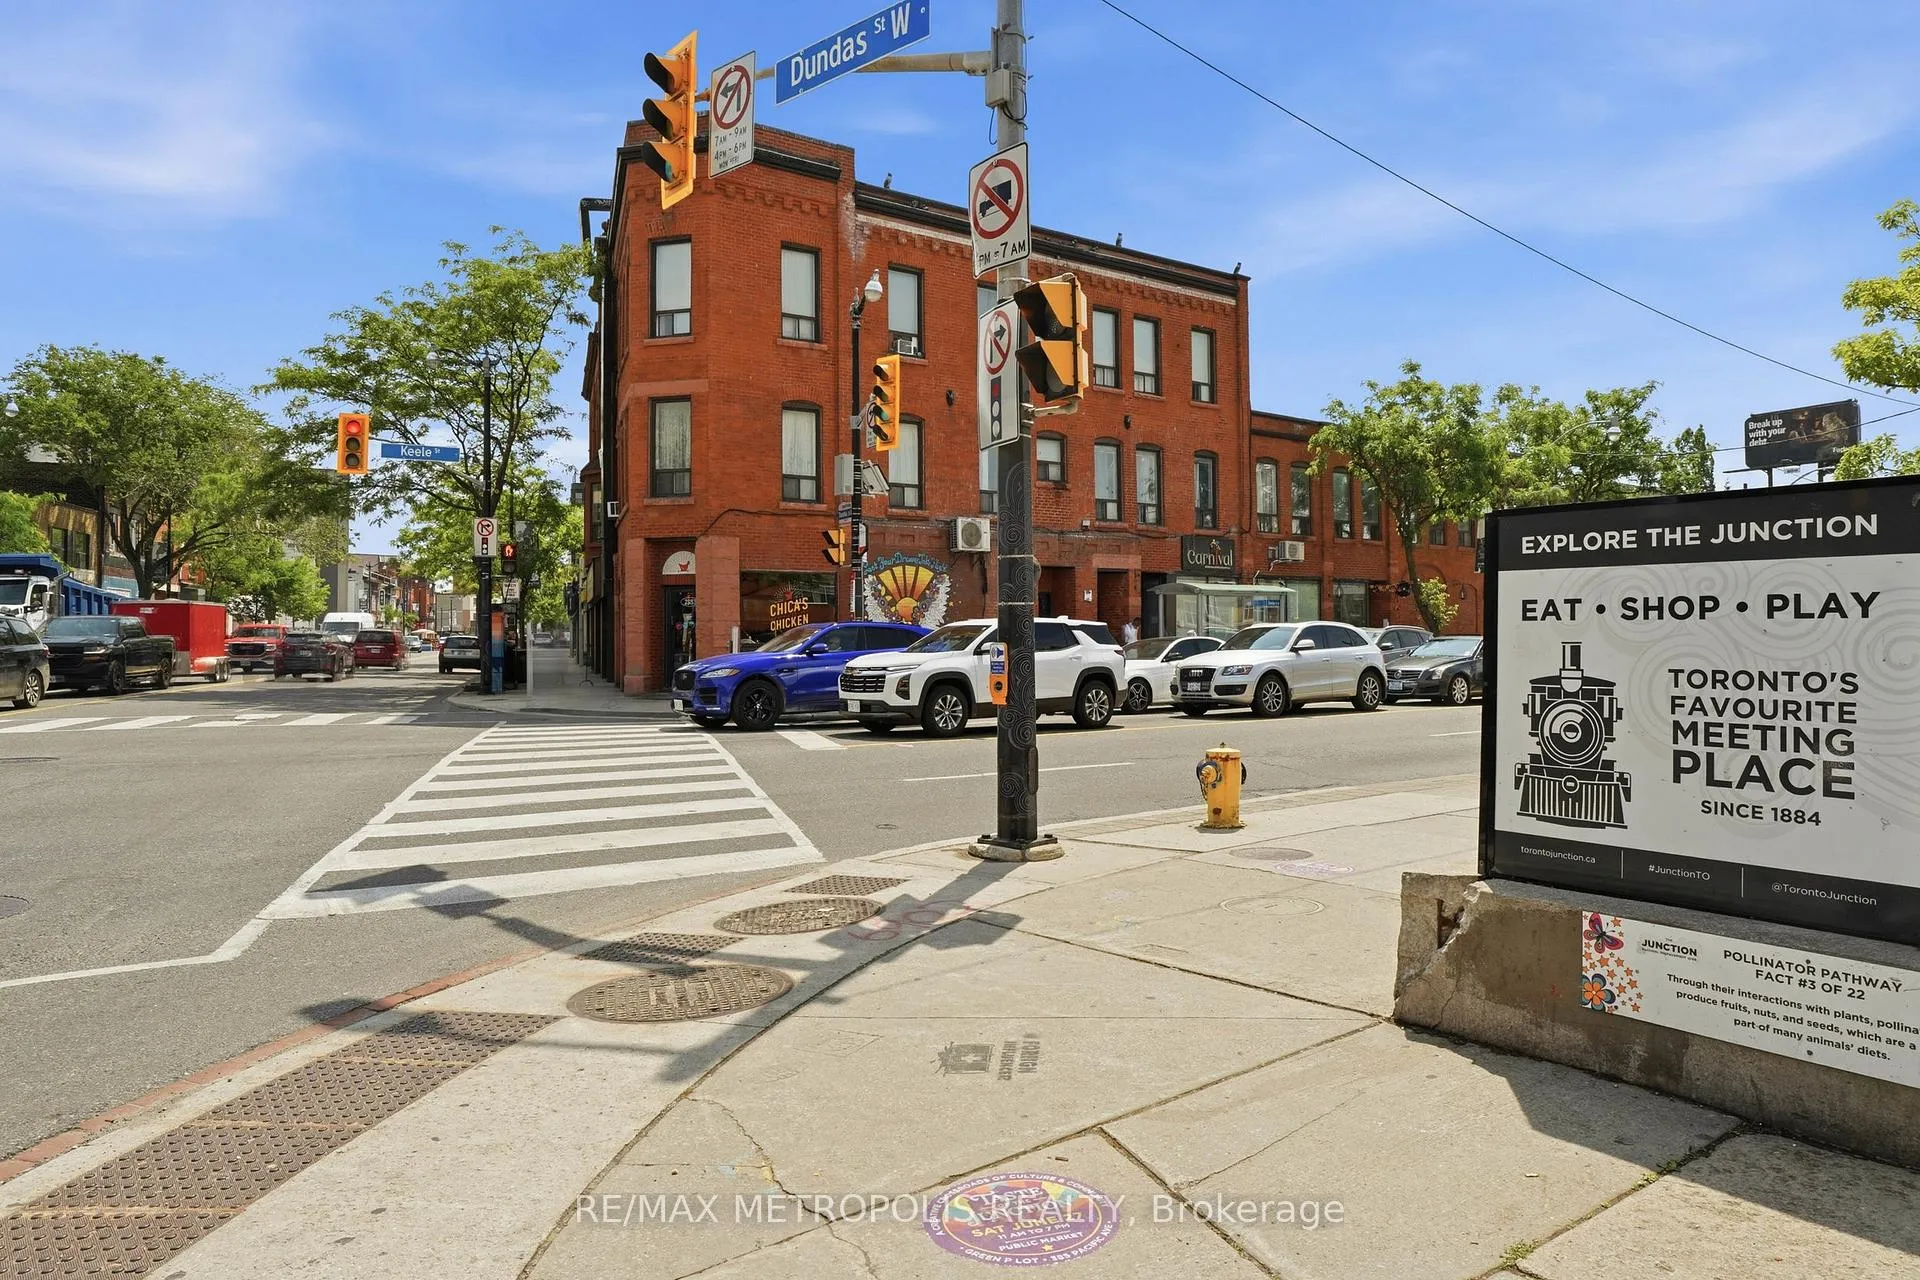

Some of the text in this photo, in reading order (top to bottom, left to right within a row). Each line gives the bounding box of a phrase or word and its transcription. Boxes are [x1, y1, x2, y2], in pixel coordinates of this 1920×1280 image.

[790, 3, 910, 87] Dundas St W
[1748, 419, 1783, 430] Break up
[1748, 427, 1787, 438] with your
[401, 445, 432, 457] Keele
[1521, 513, 1878, 555] EXPLORE THE JUNCTION
[1187, 549, 1233, 566] Carnival
[770, 597, 809, 617] CHICA'S
[1521, 591, 1881, 622] EAT SHOP PLAY
[770, 614, 809, 631] CHICKEN
[1668, 668, 1859, 695] TORONTO'S
[1670, 695, 1857, 724] FAVOURITE
[1672, 720, 1855, 756] MEETING
[1672, 749, 1856, 800] PLACE
[1700, 799, 1821, 826] SINCE 1884
[1521, 845, 1596, 864] torontojunction.ca
[1648, 864, 1710, 881] #JunctionTO
[1771, 882, 1877, 906] @TorontoJunction
[1641, 939, 1697, 956] JUNCTION
[1723, 949, 1816, 976] POLLINATOR
[1821, 968, 1903, 993] PATHWAY
[1755, 969, 1865, 1000] FACT #3 OF 22
[1667, 973, 1920, 1036] Through their interactions with plants, pollina
[1676, 991, 1917, 1051] produce fruits, nuts, and seeds, which are a
[1733, 1018, 1756, 1031] part
[1758, 1023, 1770, 1033] of
[1773, 1028, 1804, 1041] many
[1857, 1046, 1891, 1061] diets.
[1008, 1173, 1057, 1181] CULTURE
[968, 1189, 1043, 1206] TASTE
[971, 1224, 1005, 1238] SAT
[1012, 1215, 1058, 1231] JUNE
[1010, 1230, 1027, 1239] AM
[1027, 1227, 1044, 1235] TO
[1054, 1222, 1070, 1231] PM
[965, 1248, 1004, 1264] GREEN
[1071, 1235, 1105, 1256] PACIFIC
[999, 1231, 1084, 1252] PUBLIC MARKET
